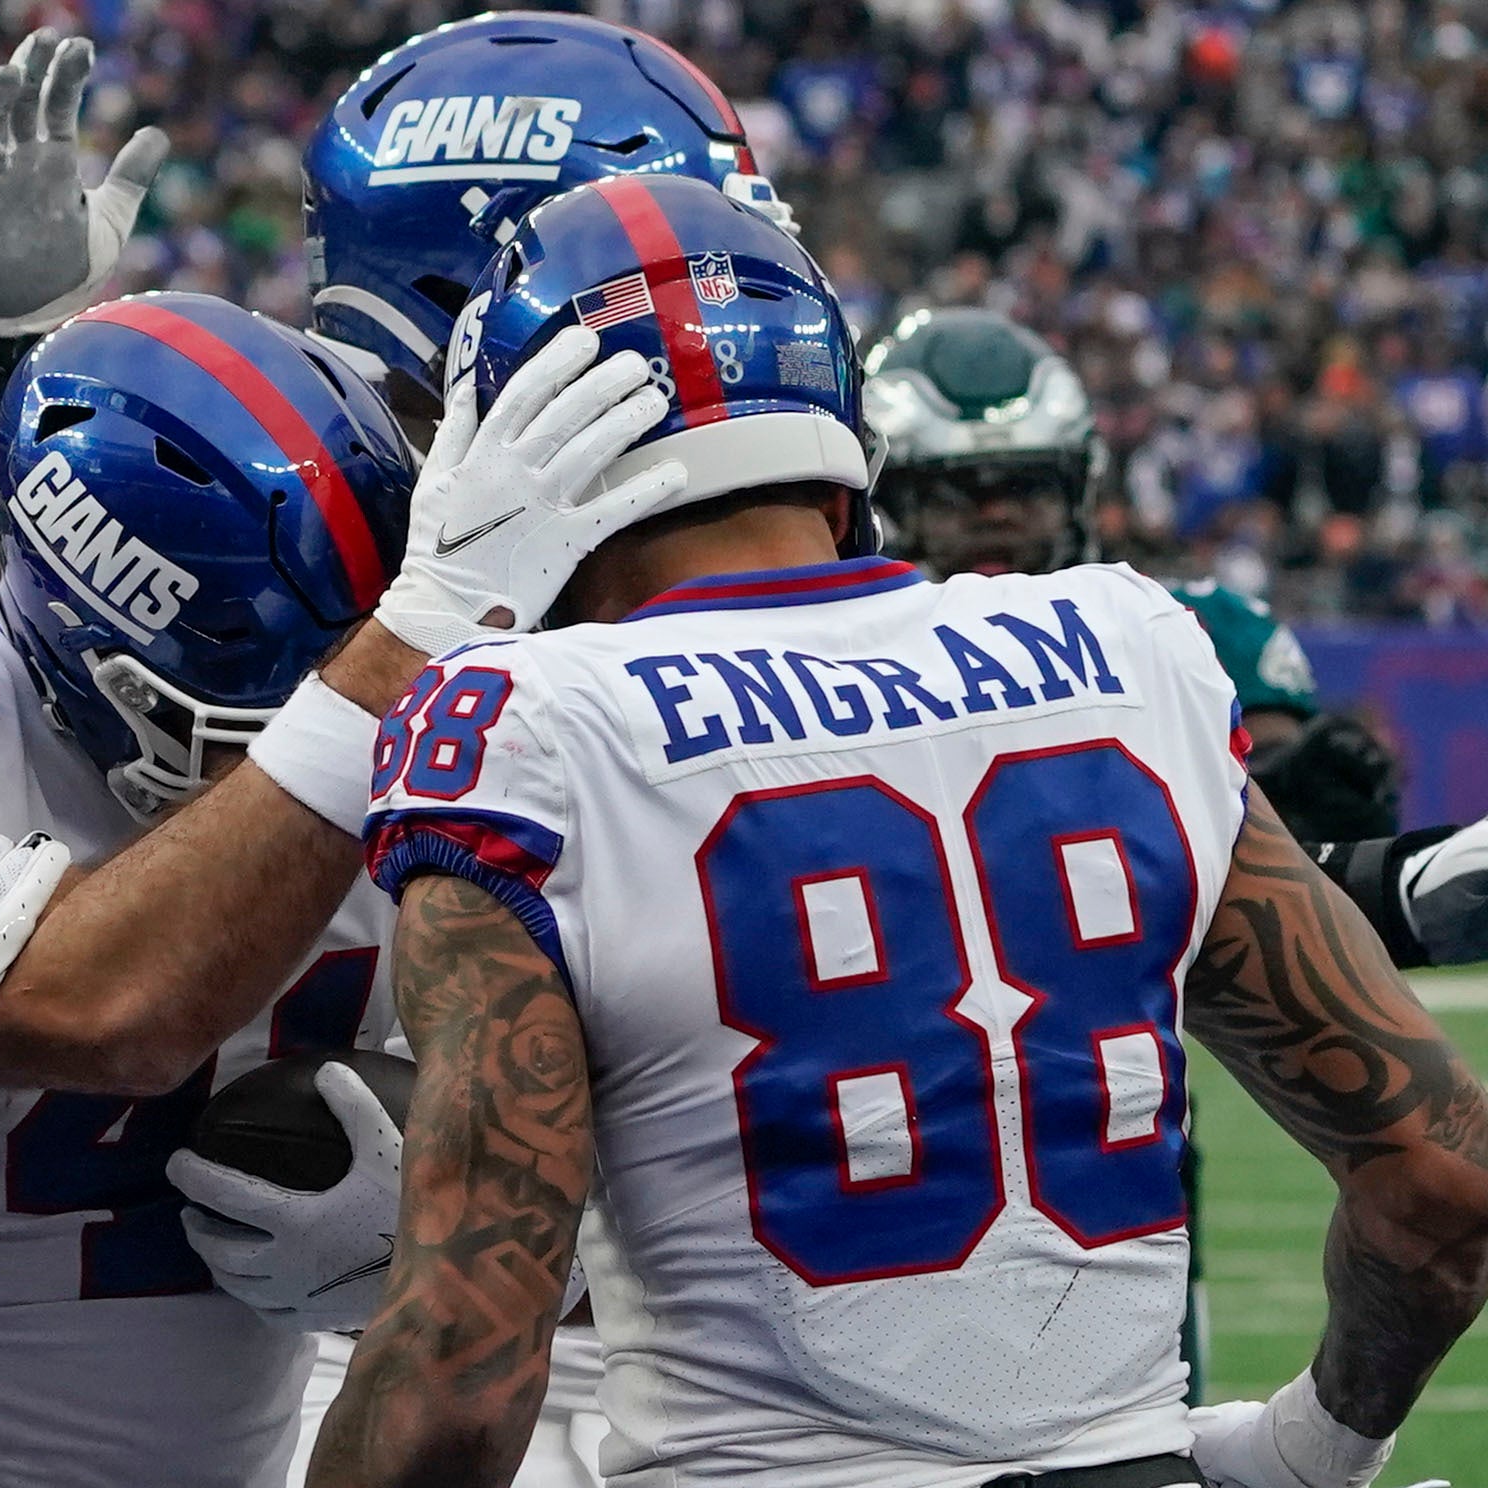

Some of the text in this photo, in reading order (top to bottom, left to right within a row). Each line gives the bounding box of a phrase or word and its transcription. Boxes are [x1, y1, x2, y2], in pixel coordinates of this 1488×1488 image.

[375, 96, 582, 167] GIANTS
[715, 340, 744, 384] 8
[16, 451, 199, 630] GIANTS
[371, 665, 514, 802] 88
[625, 598, 1126, 765] ENGRAM
[694, 738, 1198, 1288] 88
